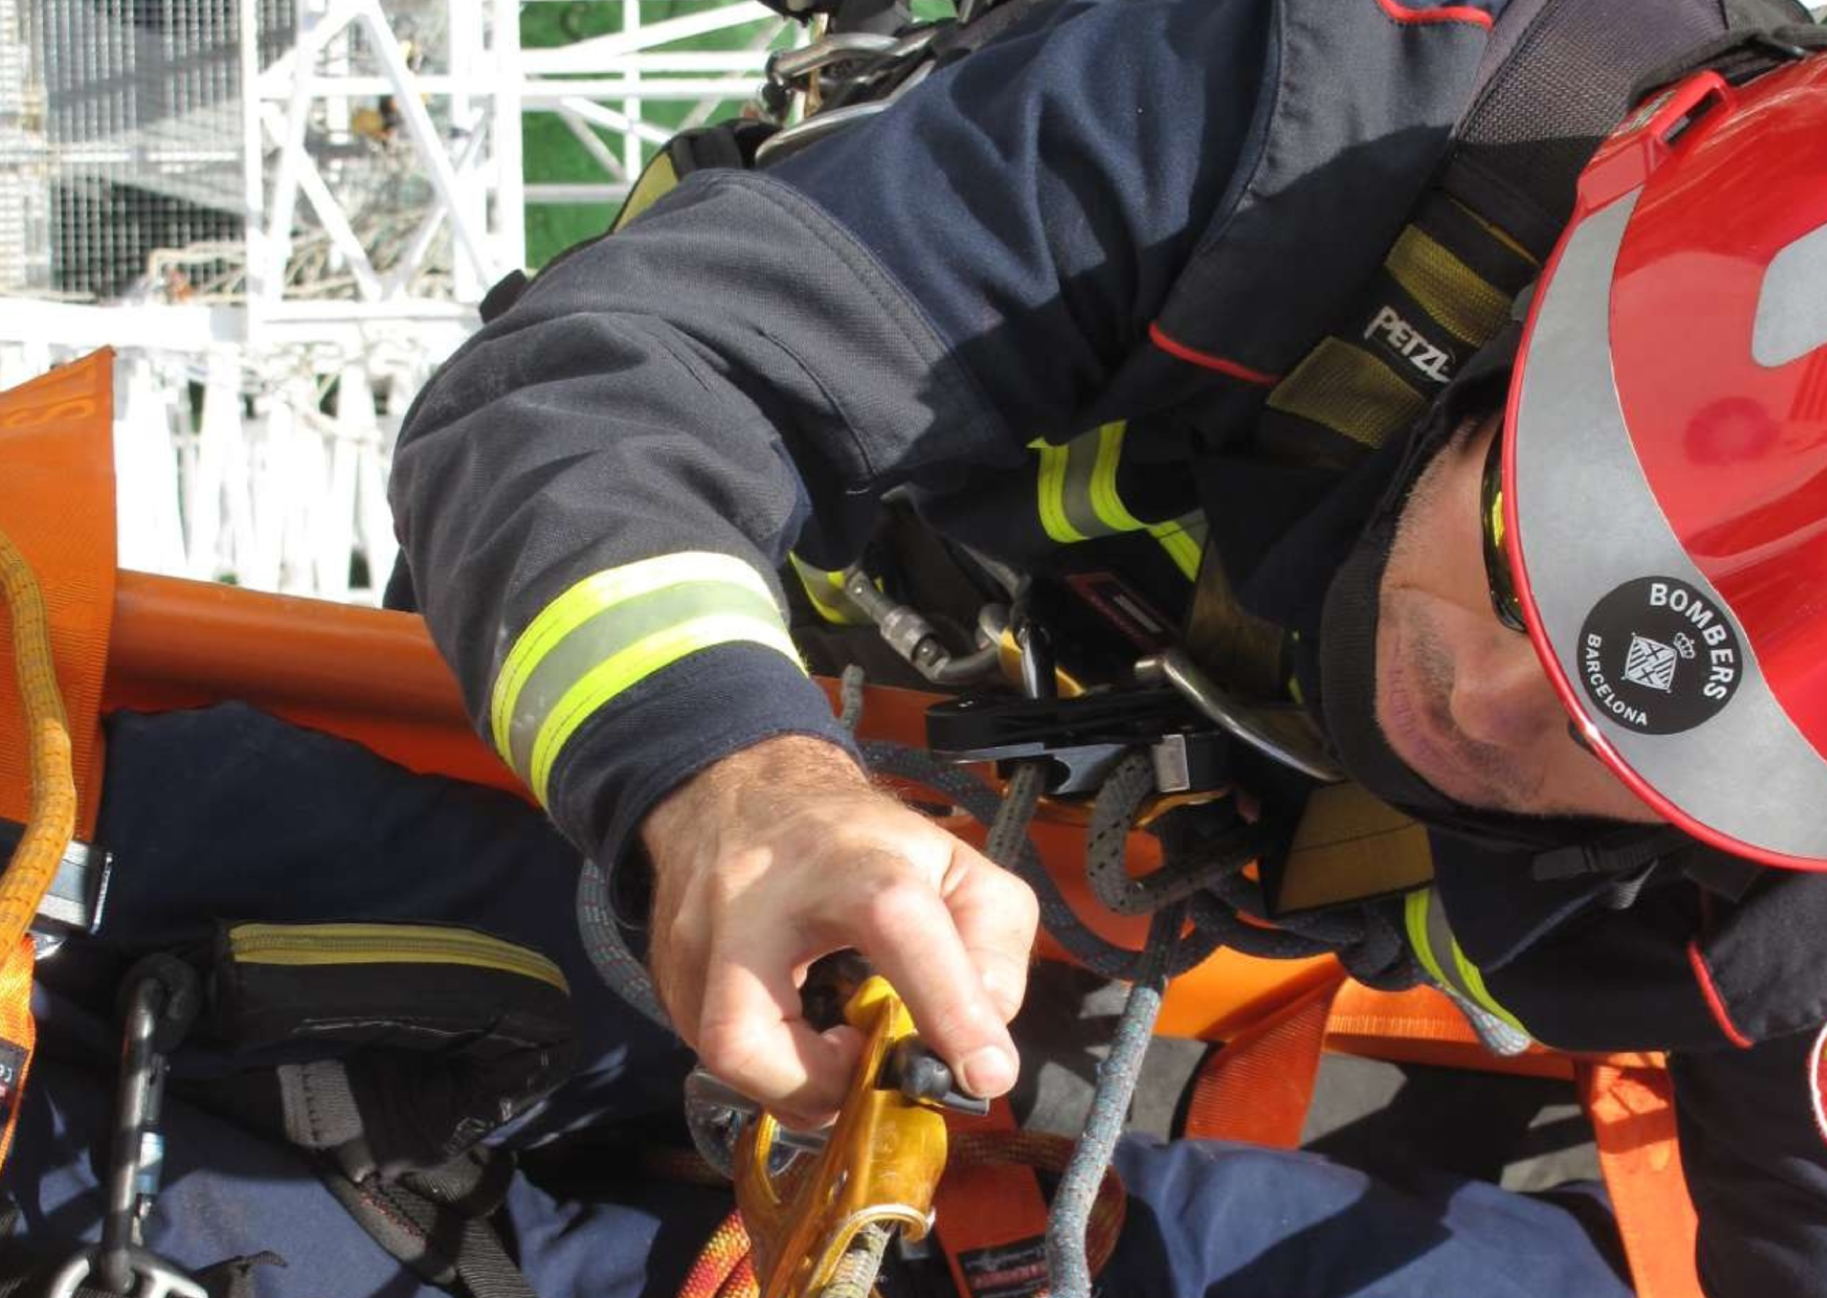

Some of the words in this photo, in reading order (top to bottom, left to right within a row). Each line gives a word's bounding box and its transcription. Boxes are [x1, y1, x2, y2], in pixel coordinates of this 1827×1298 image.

[1364, 305, 1451, 383] PETZL
[1585, 633, 1648, 726] BARCELONA
[1649, 582, 1734, 700] BOMBERS
